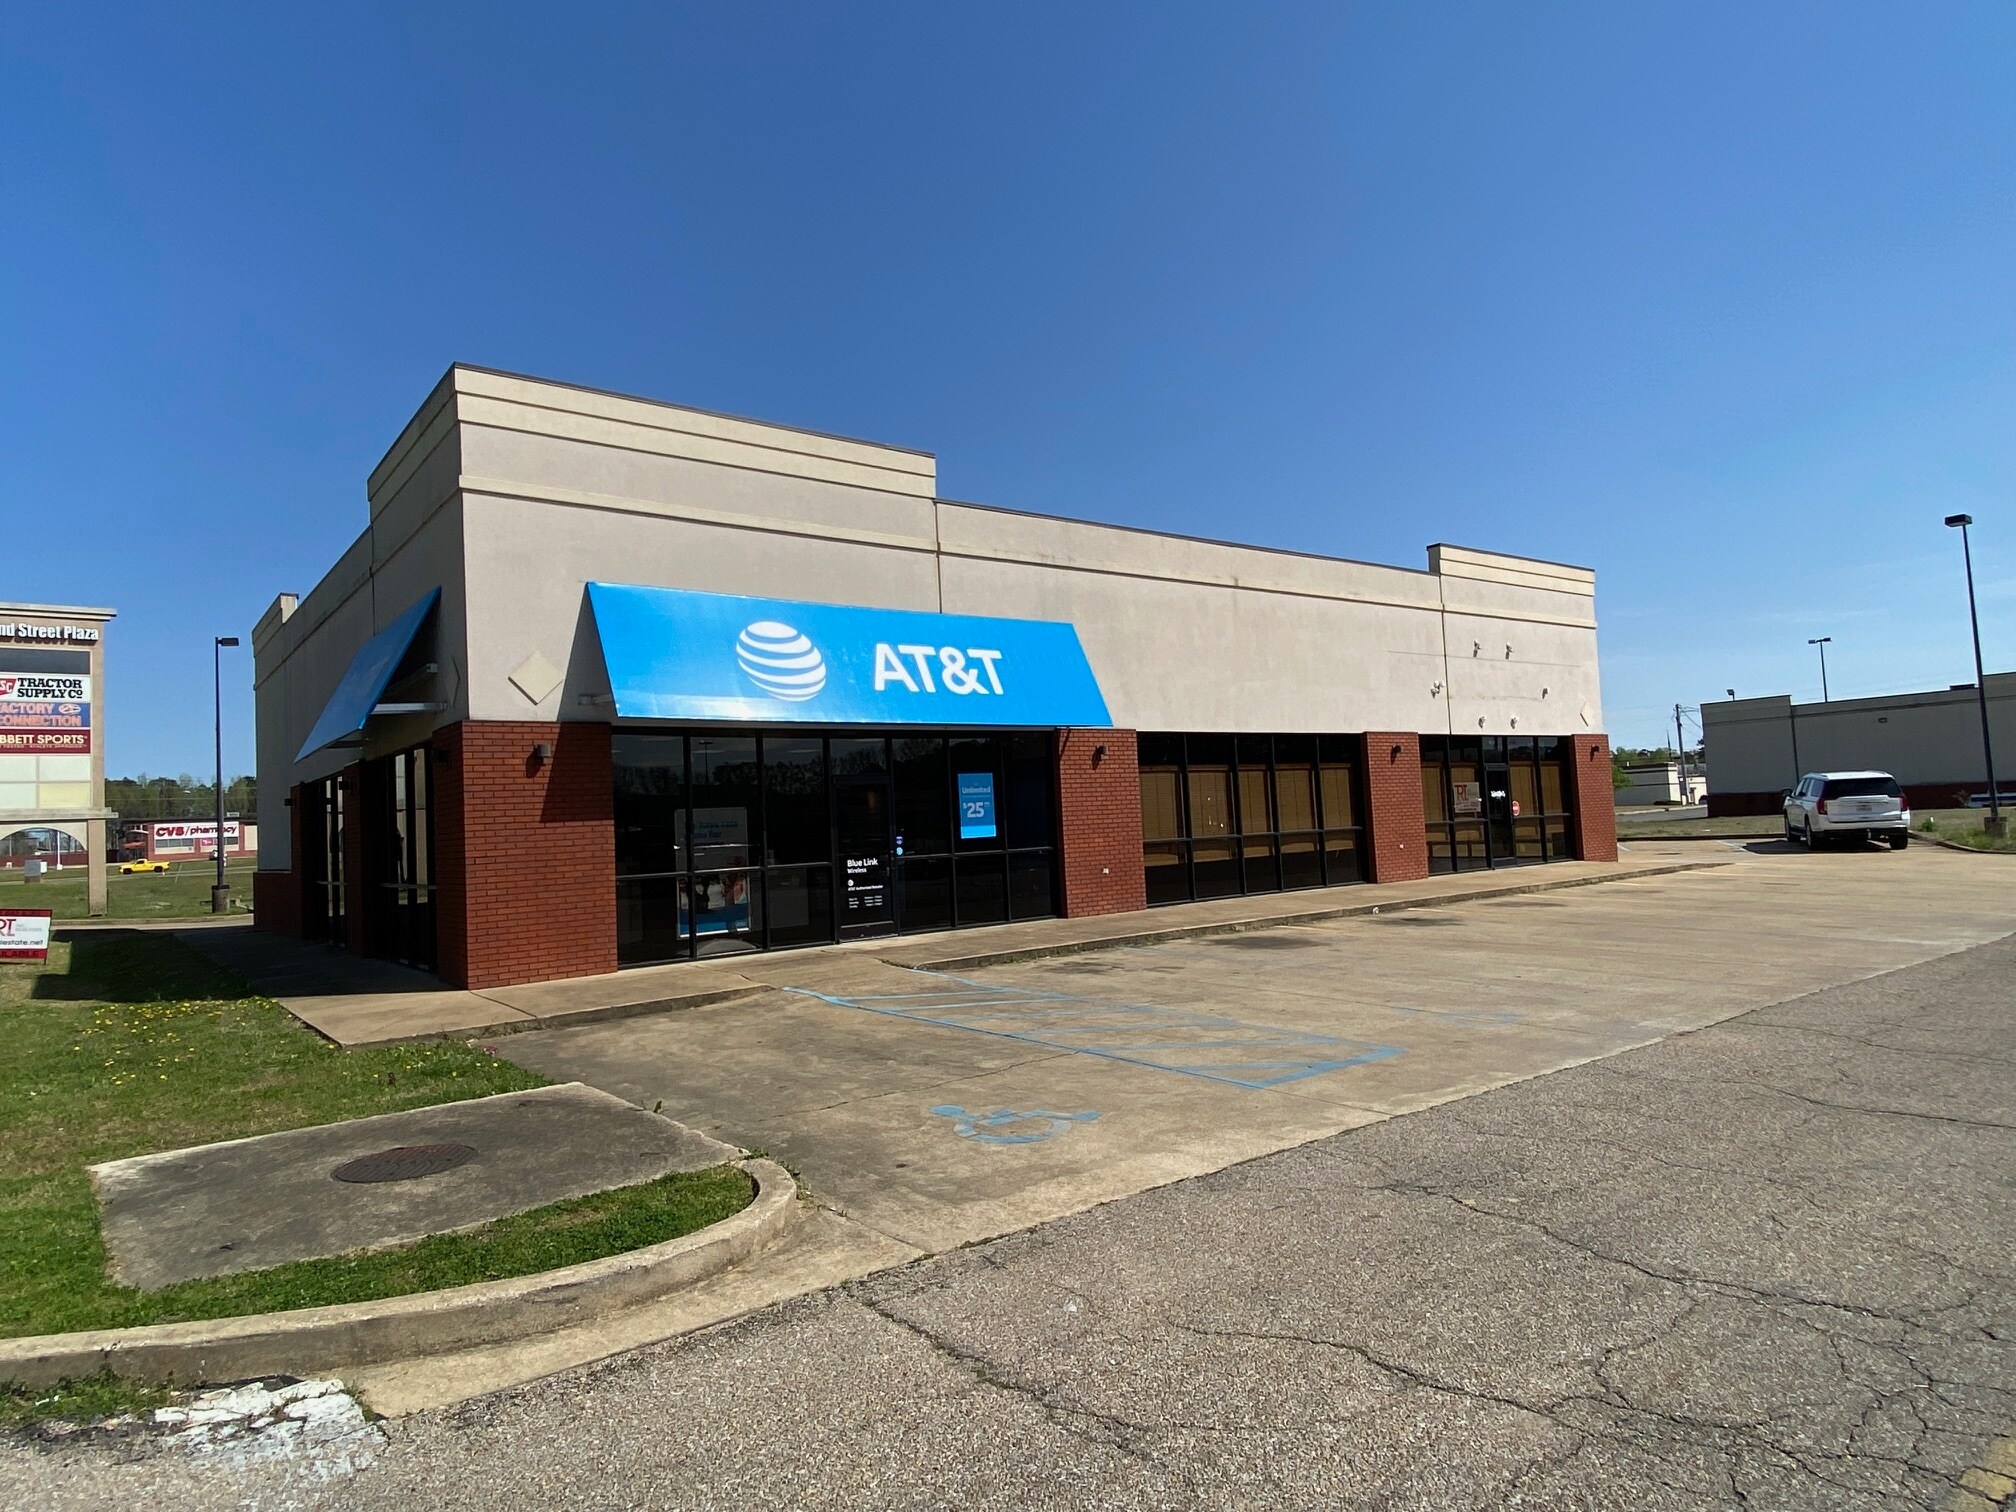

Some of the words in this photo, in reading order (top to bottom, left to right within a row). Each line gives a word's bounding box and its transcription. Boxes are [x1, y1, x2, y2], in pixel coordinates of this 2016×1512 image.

[18, 623, 62, 639] Street
[63, 625, 99, 640] Plaza
[874, 643, 1004, 696] AT&T
[17, 677, 83, 689] TRACTOR
[17, 688, 67, 699] SUPPLY
[0, 702, 55, 714] ACTORY
[37, 734, 84, 744] SPORTS
[847, 859, 863, 867] Blue
[863, 858, 878, 866] Link
